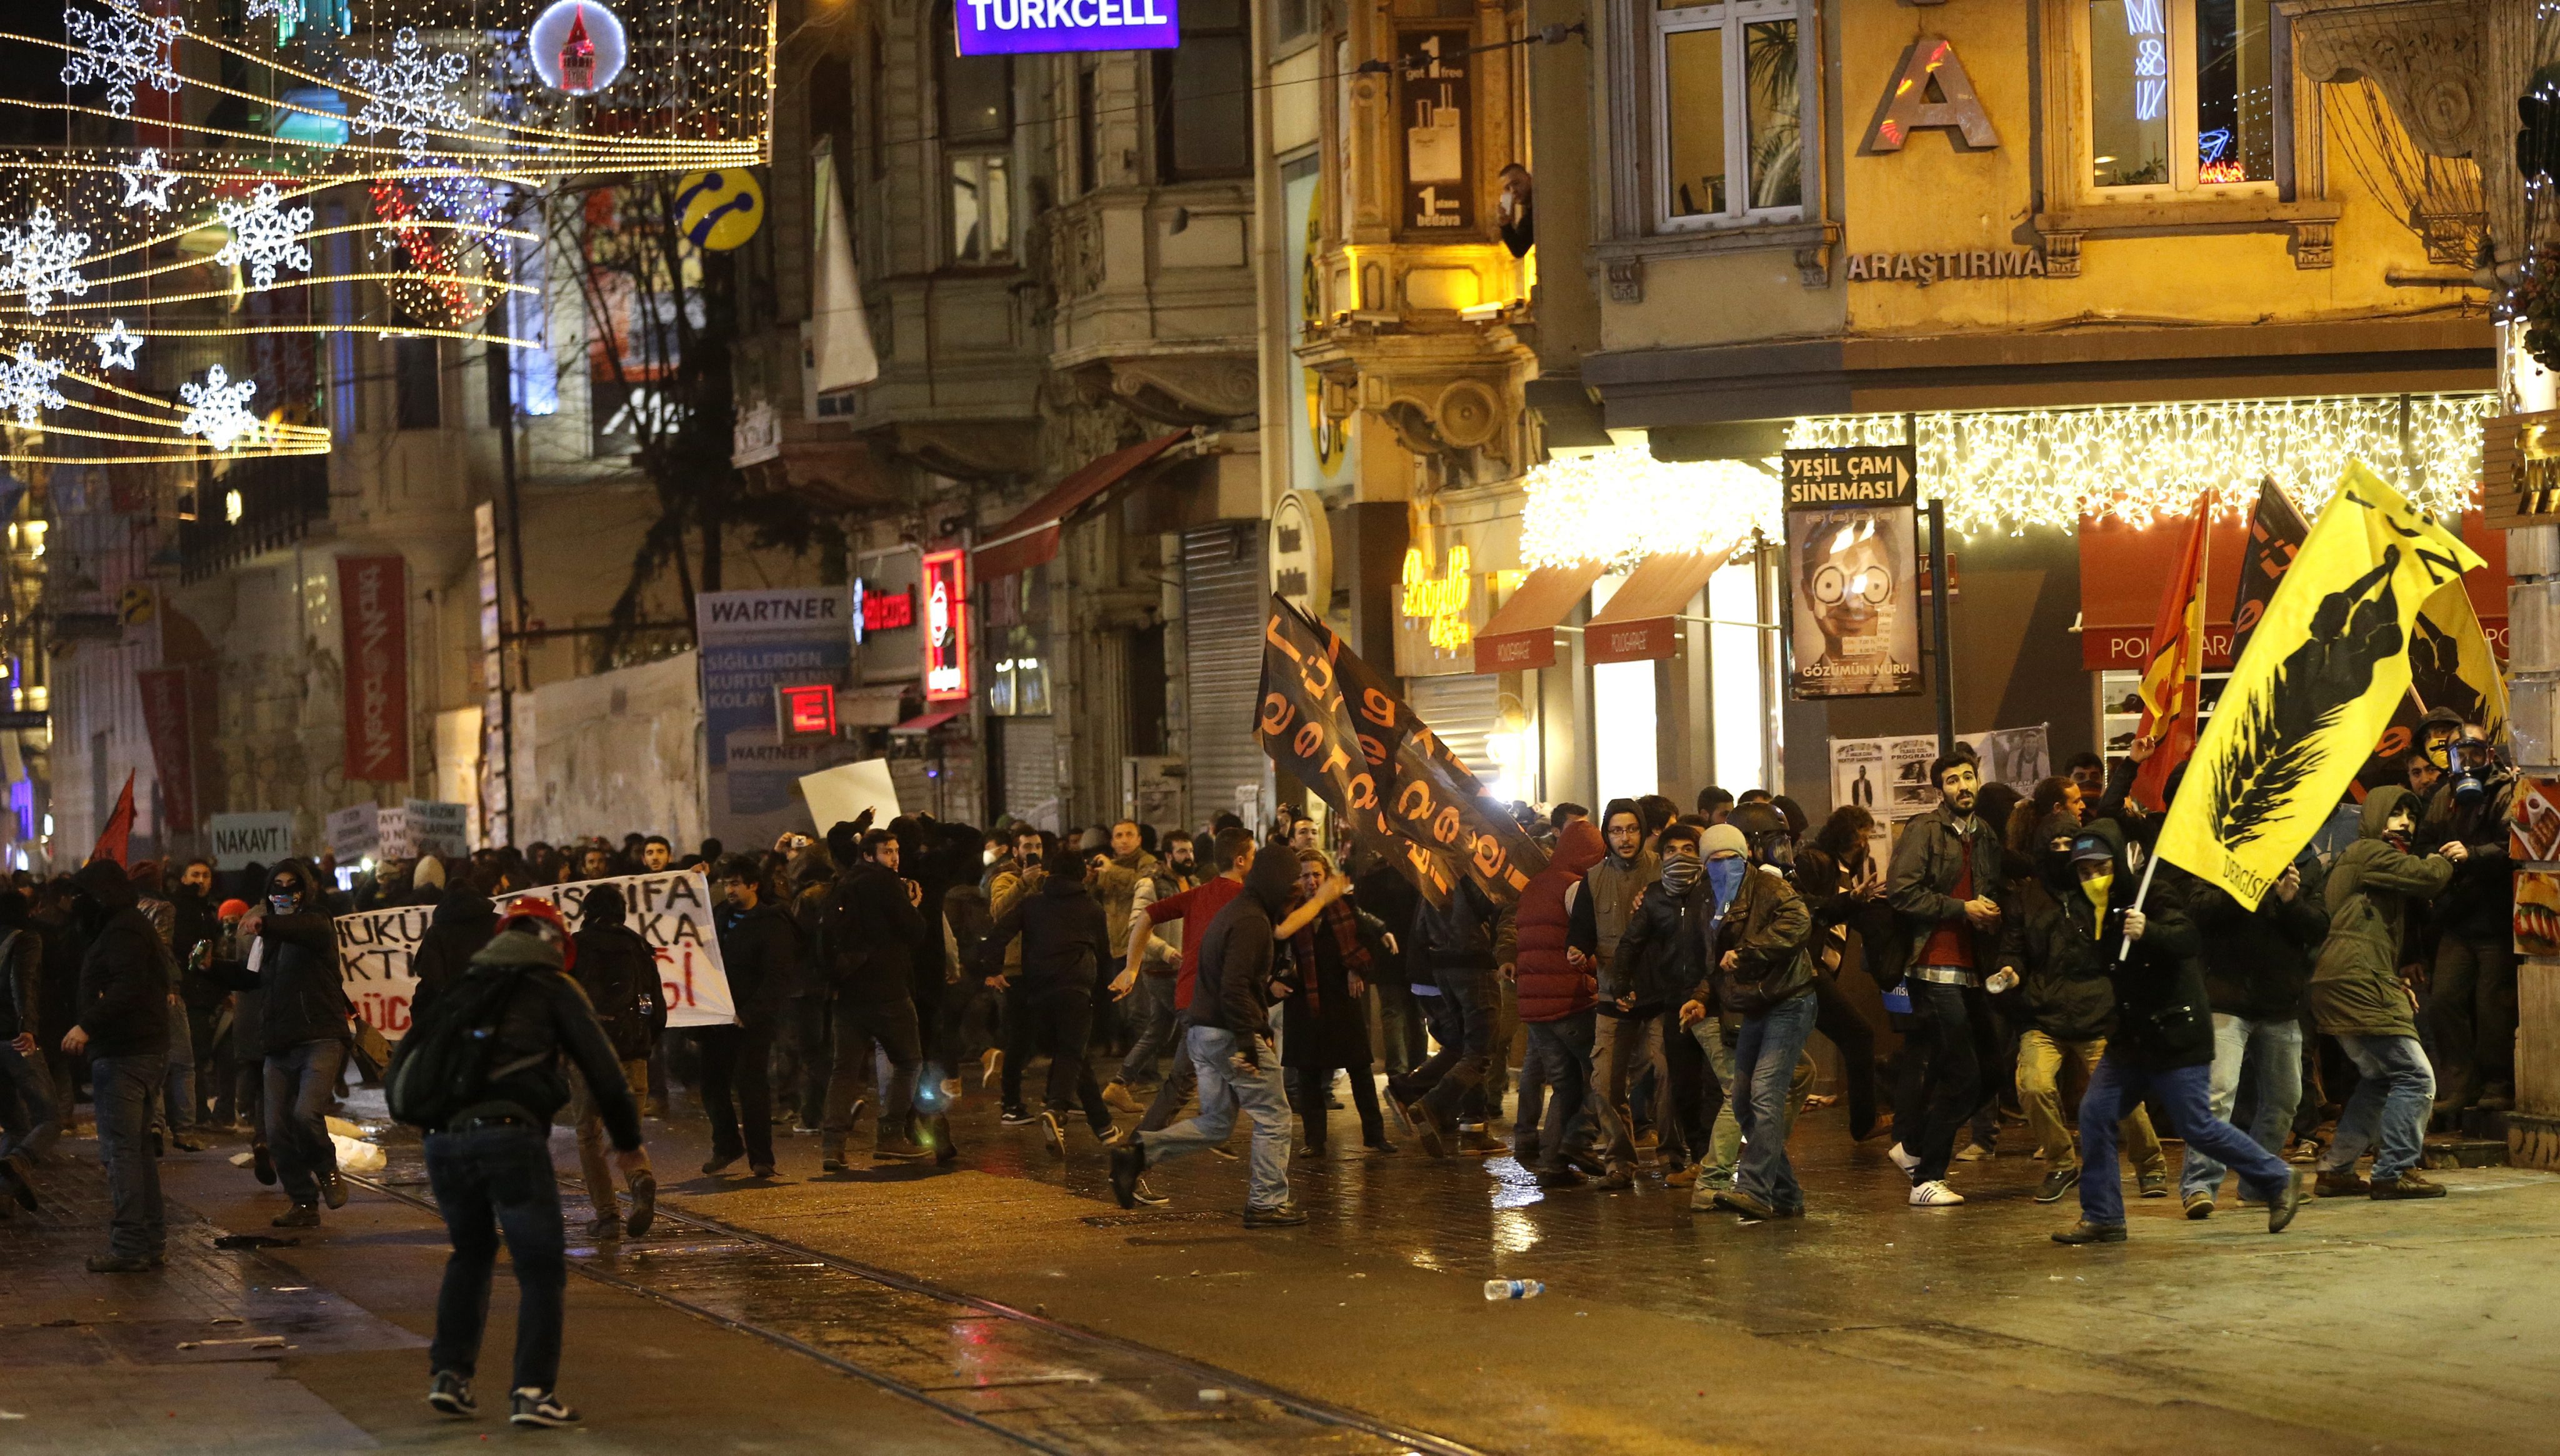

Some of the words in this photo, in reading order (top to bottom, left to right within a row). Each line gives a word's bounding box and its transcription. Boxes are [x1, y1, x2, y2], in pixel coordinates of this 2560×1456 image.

[1420, 35, 1439, 79] 1
[1441, 66, 1464, 78] free
[1871, 39, 1999, 151] A
[1418, 186, 1436, 216] 1
[1417, 213, 1461, 227] bedava
[1848, 248, 2045, 284] ARAŞTIRMA
[1789, 453, 1841, 482] YEŞİL
[1847, 456, 1892, 481] ÇAM
[1791, 479, 1893, 502] SİNEMASI
[712, 598, 836, 622] WARTNER
[1802, 662, 1870, 677] GÖZÜMÜN
[1874, 663, 1910, 675] NURU
[792, 693, 826, 732] E
[216, 828, 278, 854] NAKAVT
